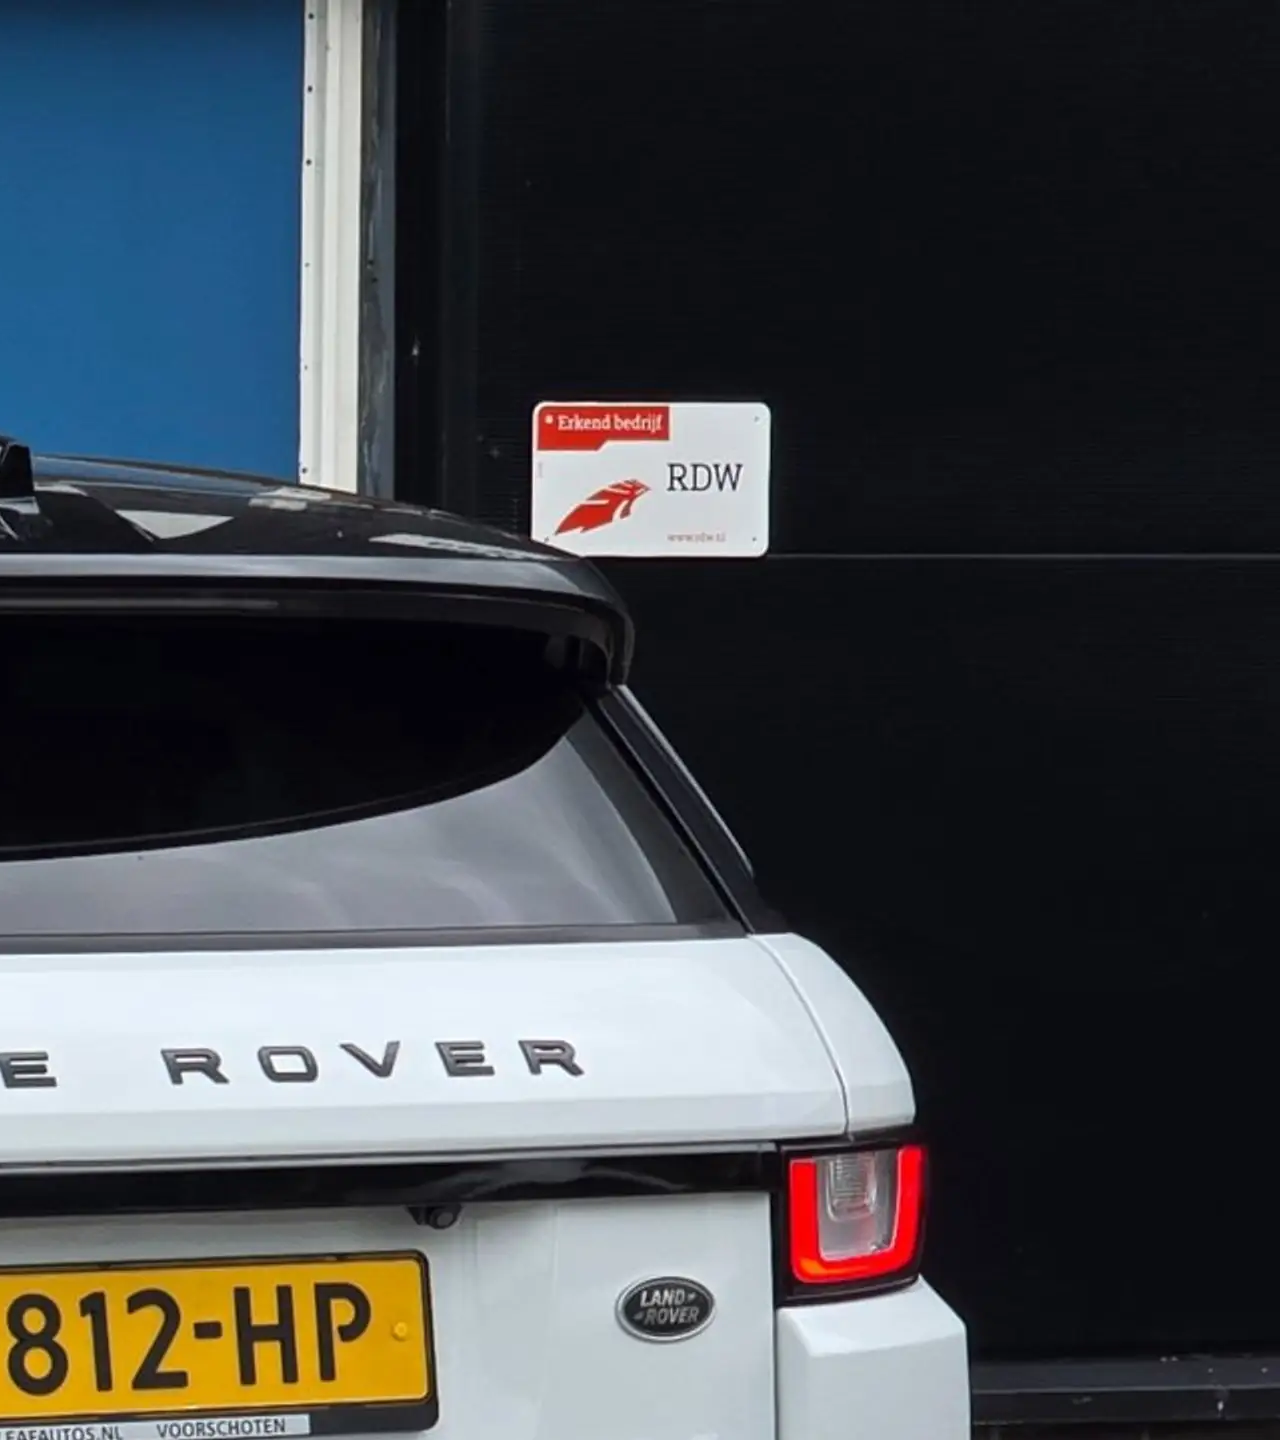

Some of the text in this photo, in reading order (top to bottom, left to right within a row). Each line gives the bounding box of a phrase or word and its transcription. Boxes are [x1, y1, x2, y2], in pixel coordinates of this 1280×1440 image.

[557, 413, 663, 434] Erkend bedrijf
[666, 463, 743, 492] RDW
[160, 1038, 585, 1086] ROVER
[640, 1289, 685, 1308] LAND
[644, 1306, 699, 1325] ROVER
[156, 1417, 286, 1439] VOORSCHOTEN
